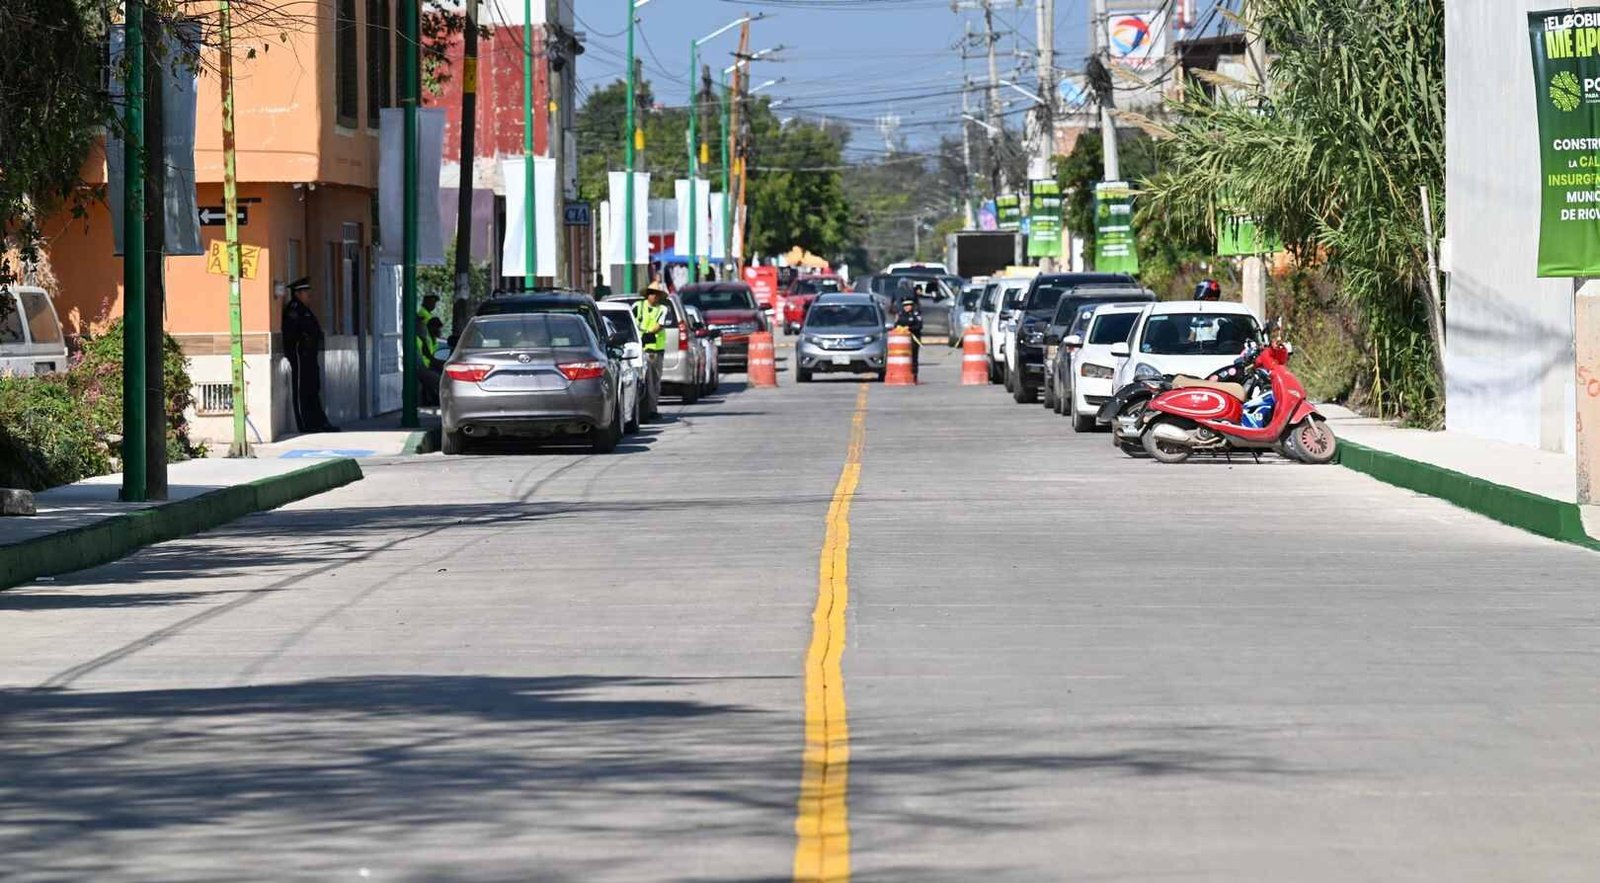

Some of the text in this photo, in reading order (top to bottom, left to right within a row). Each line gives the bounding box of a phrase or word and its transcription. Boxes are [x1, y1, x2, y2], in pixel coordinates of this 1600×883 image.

[1545, 27, 1600, 59] ME AP
[1553, 138, 1600, 151] CONSTR
[1568, 155, 1600, 168] LA CAL
[1561, 208, 1577, 221] DE
